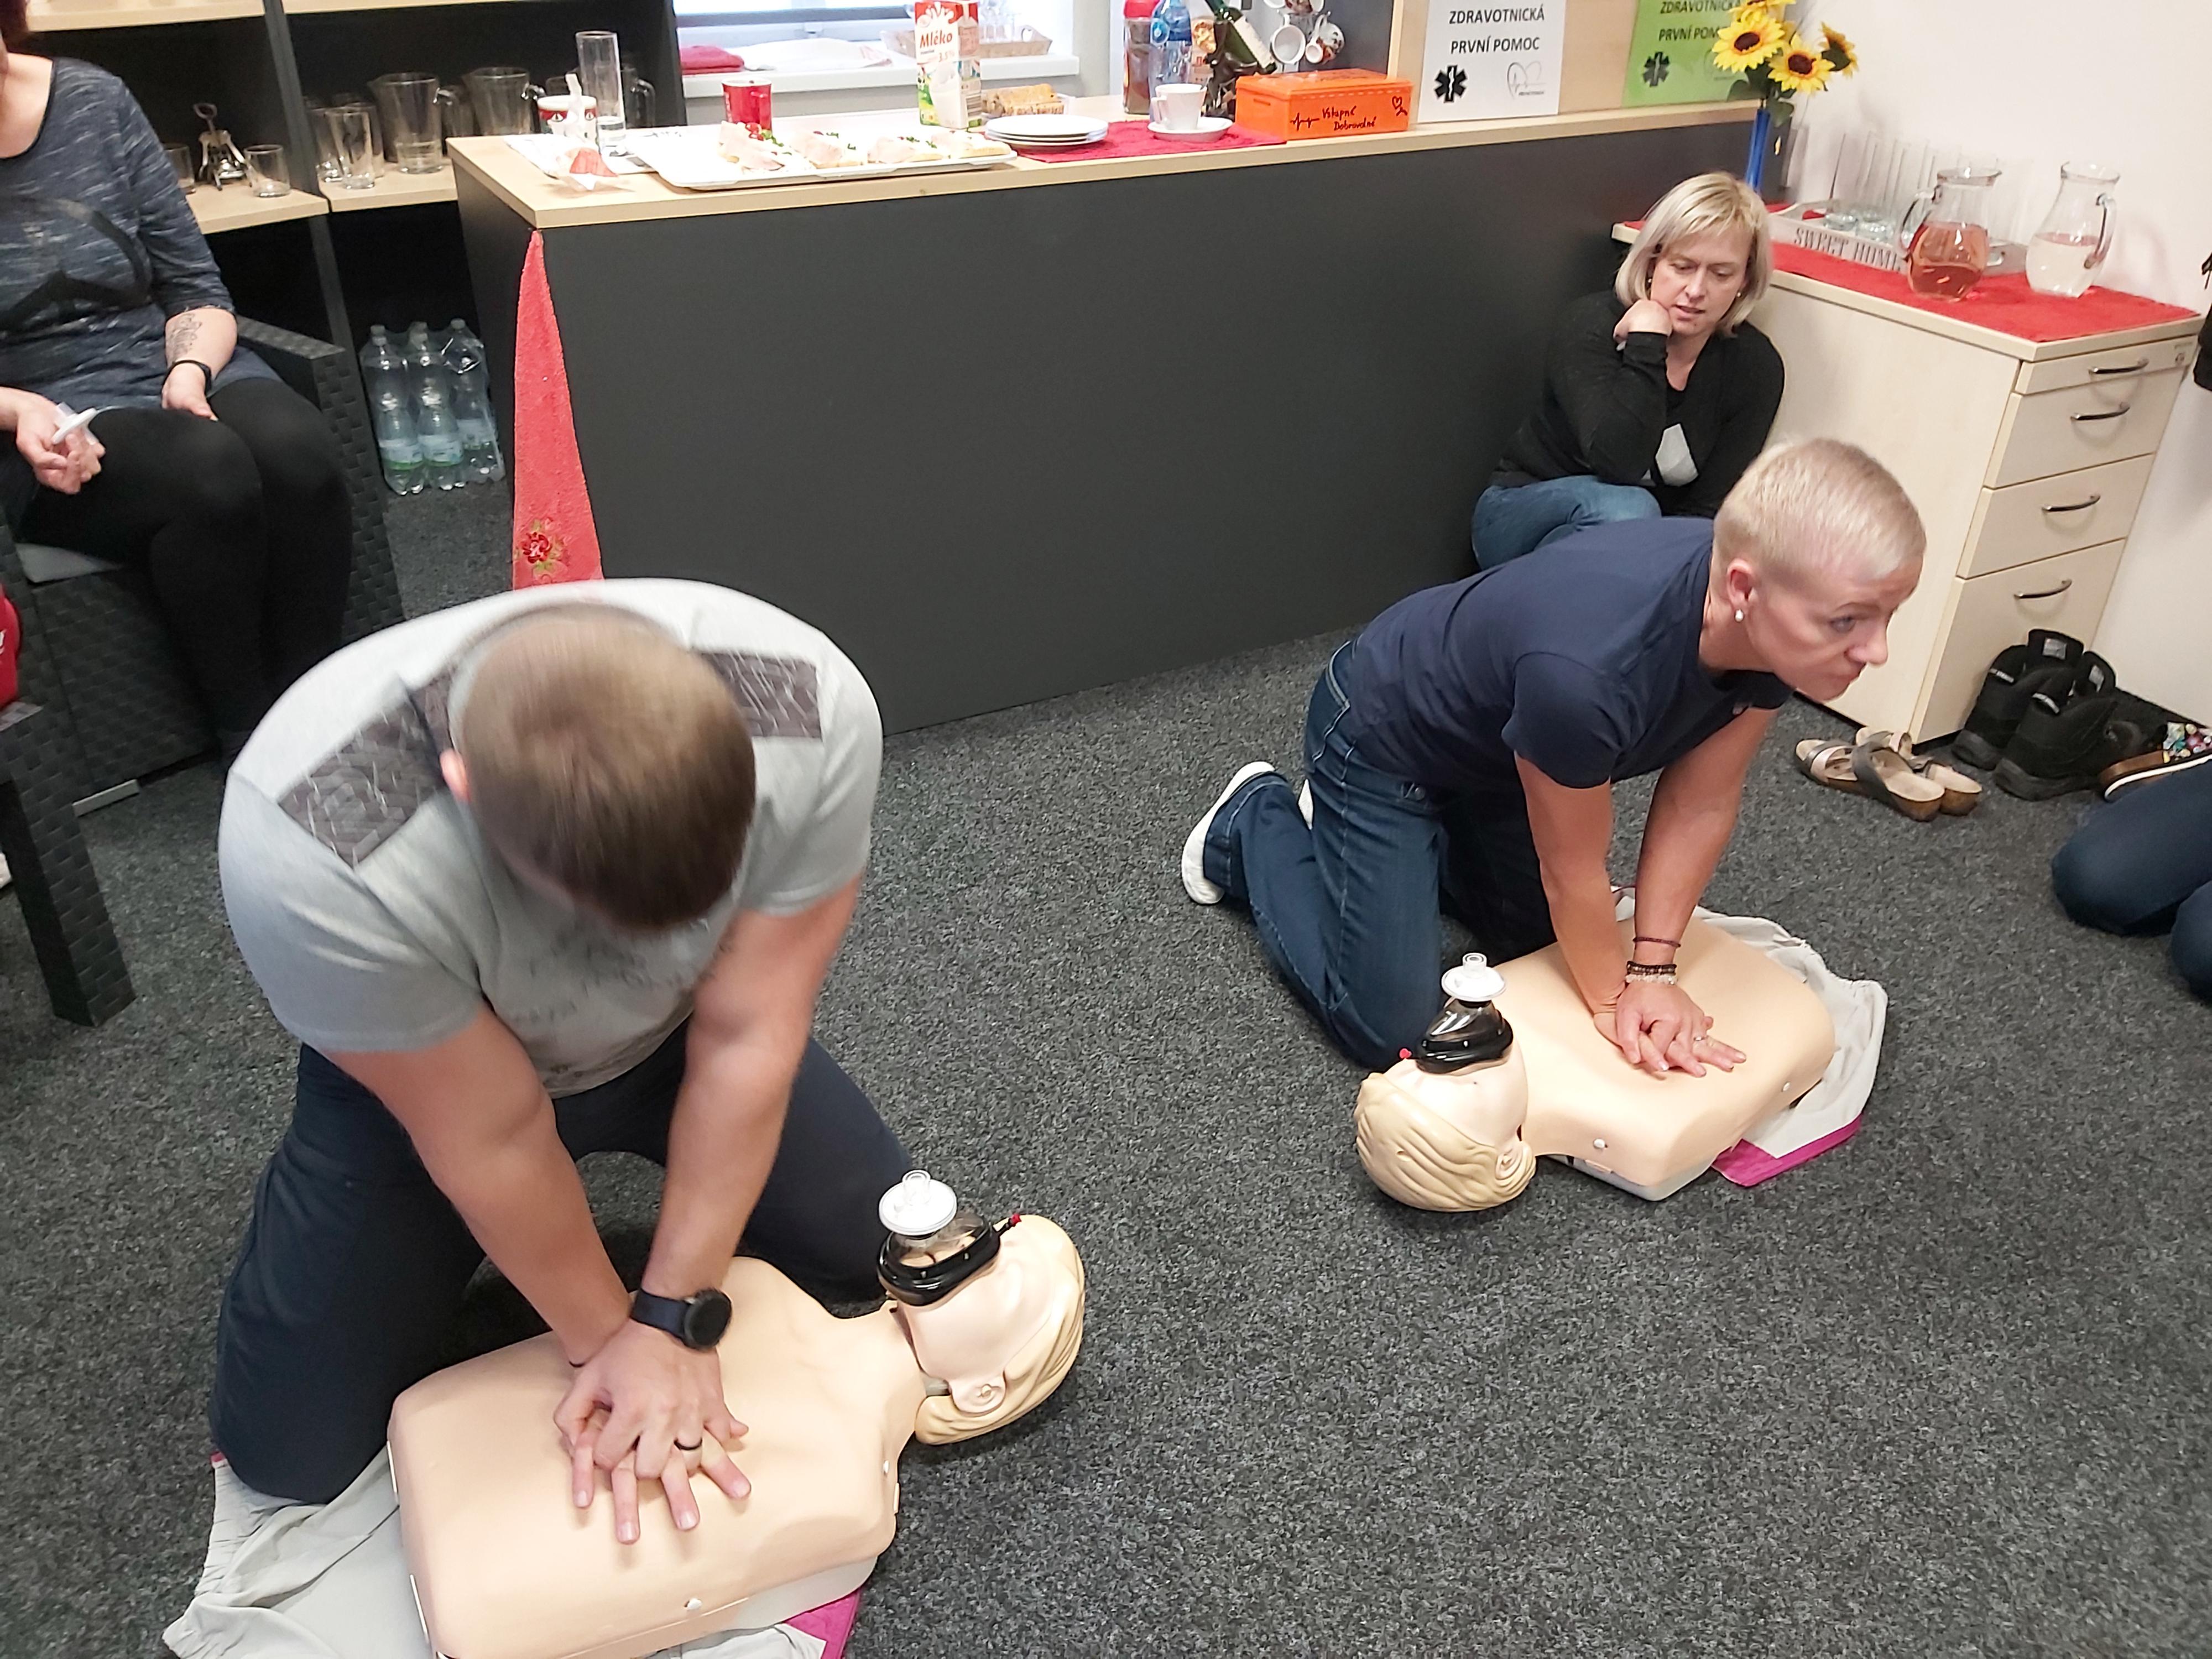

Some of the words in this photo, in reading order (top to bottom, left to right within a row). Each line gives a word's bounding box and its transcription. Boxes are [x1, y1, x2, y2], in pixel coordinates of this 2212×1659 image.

[1449, 3, 1545, 24] ZDRAVOTNICKÁ
[920, 29, 953, 49] Mléko
[1659, 25, 1692, 41] PRVNÍ
[1693, 26, 1729, 40] POM
[1451, 35, 1491, 54] PRVNÍ
[1493, 37, 1540, 52] POMOC
[1794, 227, 1849, 257] SWEET
[1854, 242, 1901, 272] HOME
